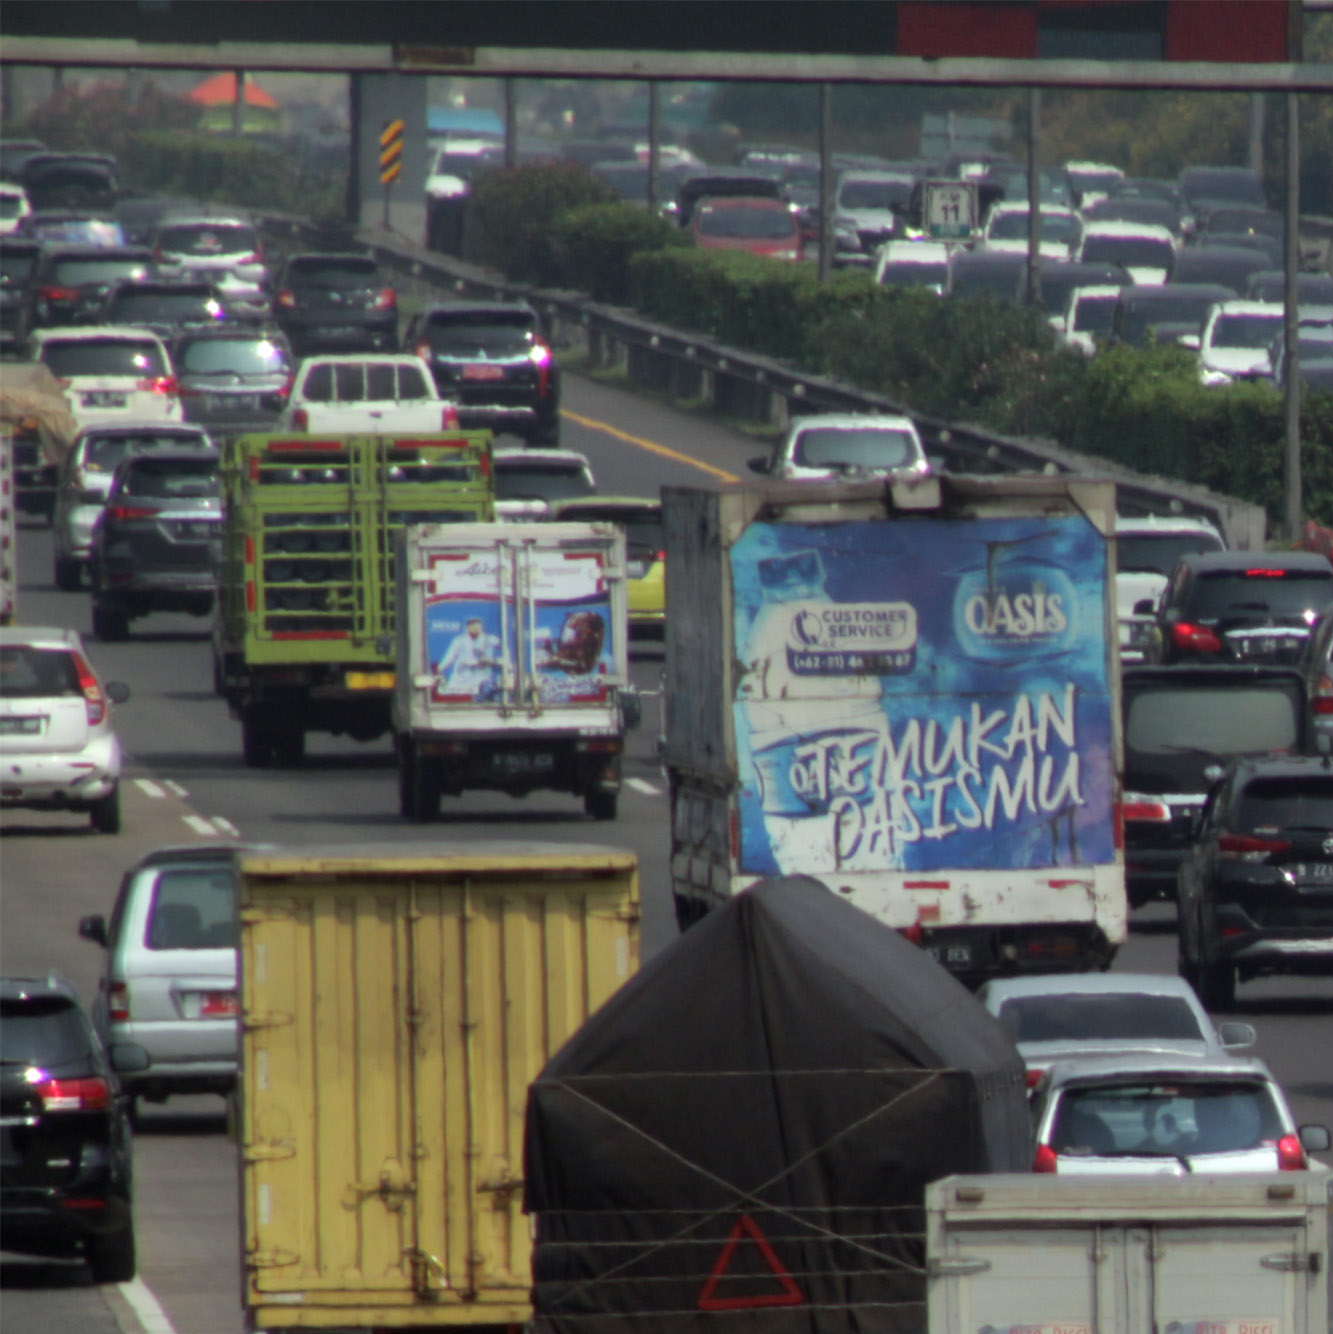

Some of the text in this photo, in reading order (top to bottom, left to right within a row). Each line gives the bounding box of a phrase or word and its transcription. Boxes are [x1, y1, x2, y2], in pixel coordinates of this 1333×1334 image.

[821, 609, 908, 623] CUSTOMER
[828, 624, 892, 638] SERVICE
[964, 593, 1067, 636] OASIS
[794, 682, 1076, 801] TEMUKAN
[828, 752, 1085, 861] OASISMU
